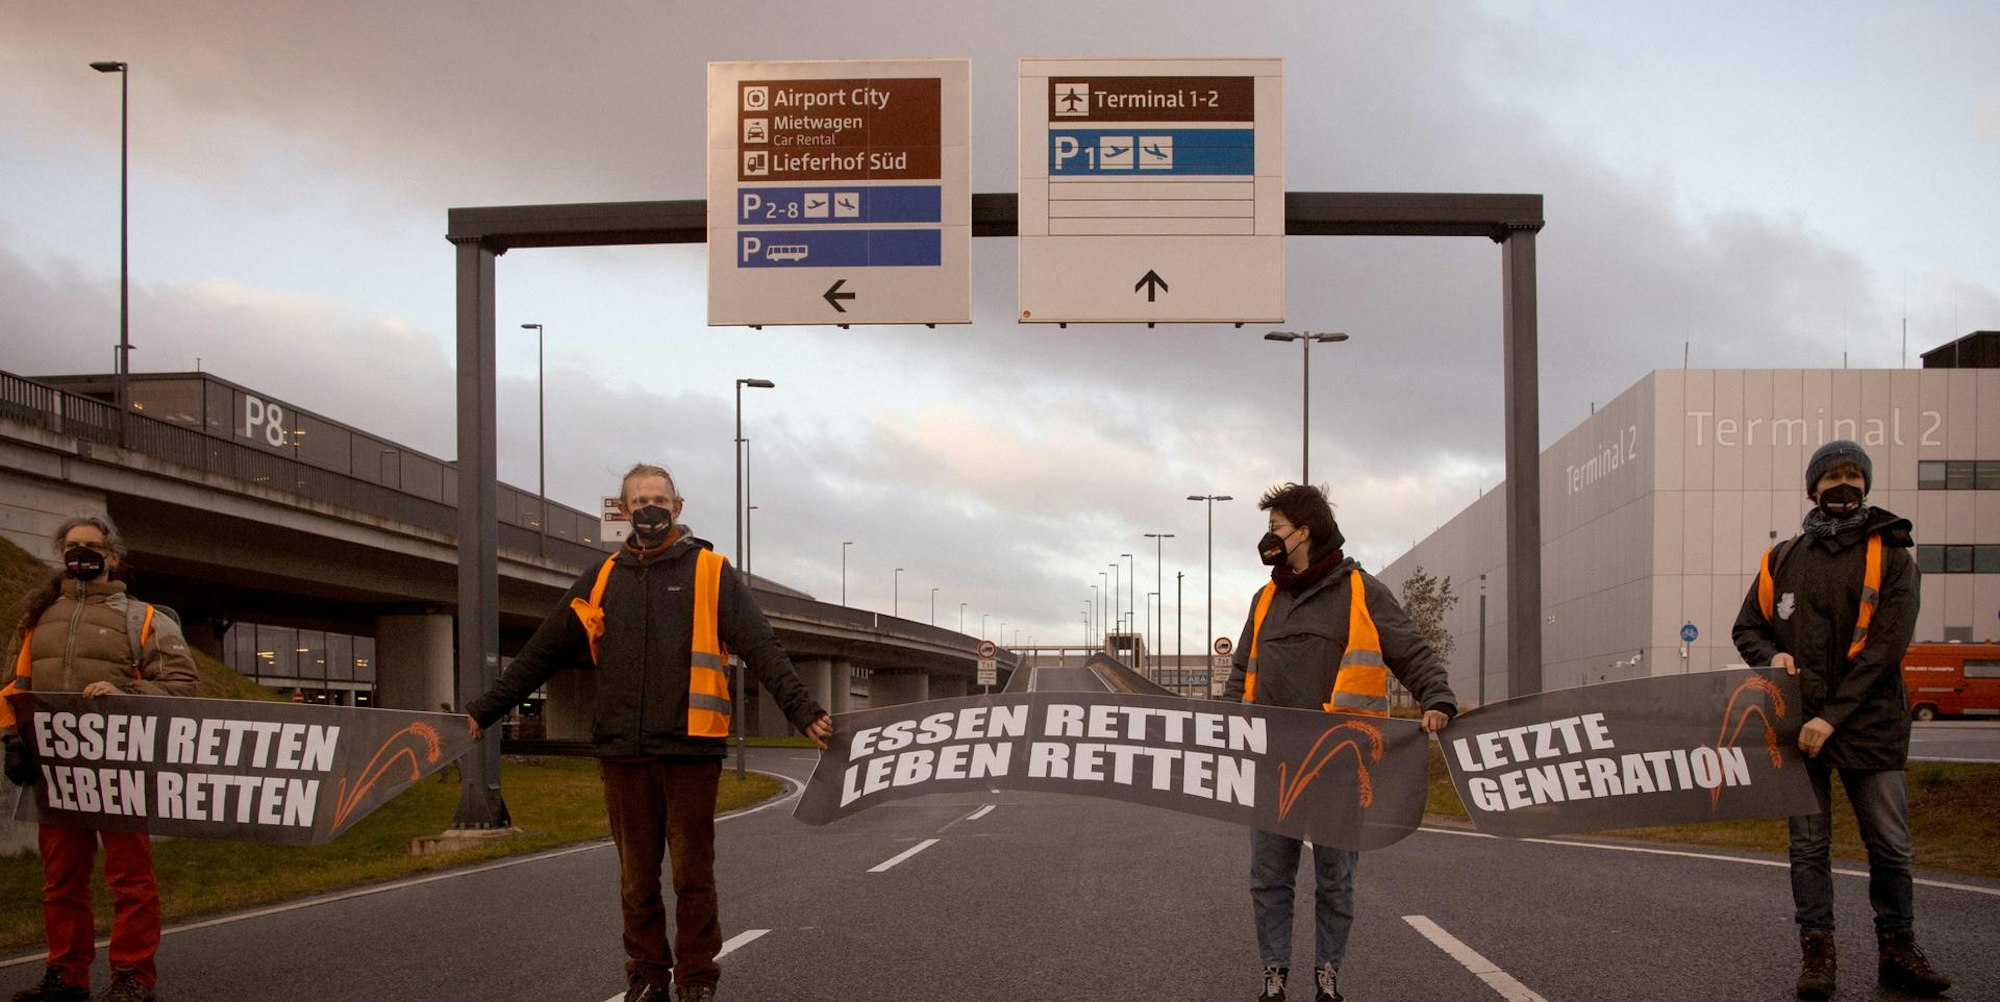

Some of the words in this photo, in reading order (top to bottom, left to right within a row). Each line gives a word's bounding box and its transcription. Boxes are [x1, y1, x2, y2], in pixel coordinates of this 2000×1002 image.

[774, 89, 846, 112] Airport
[851, 87, 890, 111] City
[774, 115, 863, 132] Mietwagen
[1094, 90, 1185, 108] Terminal
[1189, 90, 1219, 108] 1-2
[773, 153, 865, 171] Lieferhof
[870, 152, 907, 170] Süd
[774, 134, 794, 146] Car
[797, 133, 836, 146] Rental
[743, 237, 761, 262] P
[246, 394, 284, 447] P8
[1687, 407, 1904, 447] Terminal
[1921, 410, 1943, 447] 2
[1566, 438, 1626, 496] Terminal
[1628, 425, 1637, 461] 2
[34, 712, 157, 763] ESSEN
[166, 717, 341, 772] RETTEN
[848, 704, 1029, 762] ESSEN
[1044, 704, 1268, 755] RETTEN
[1453, 712, 1615, 773] LETZTE
[42, 764, 147, 817] LEBEN
[157, 771, 320, 827] RETTEN
[840, 742, 1012, 808] LEBEN
[1028, 742, 1256, 808] RETTEN
[1468, 746, 1752, 812] GENERATION
